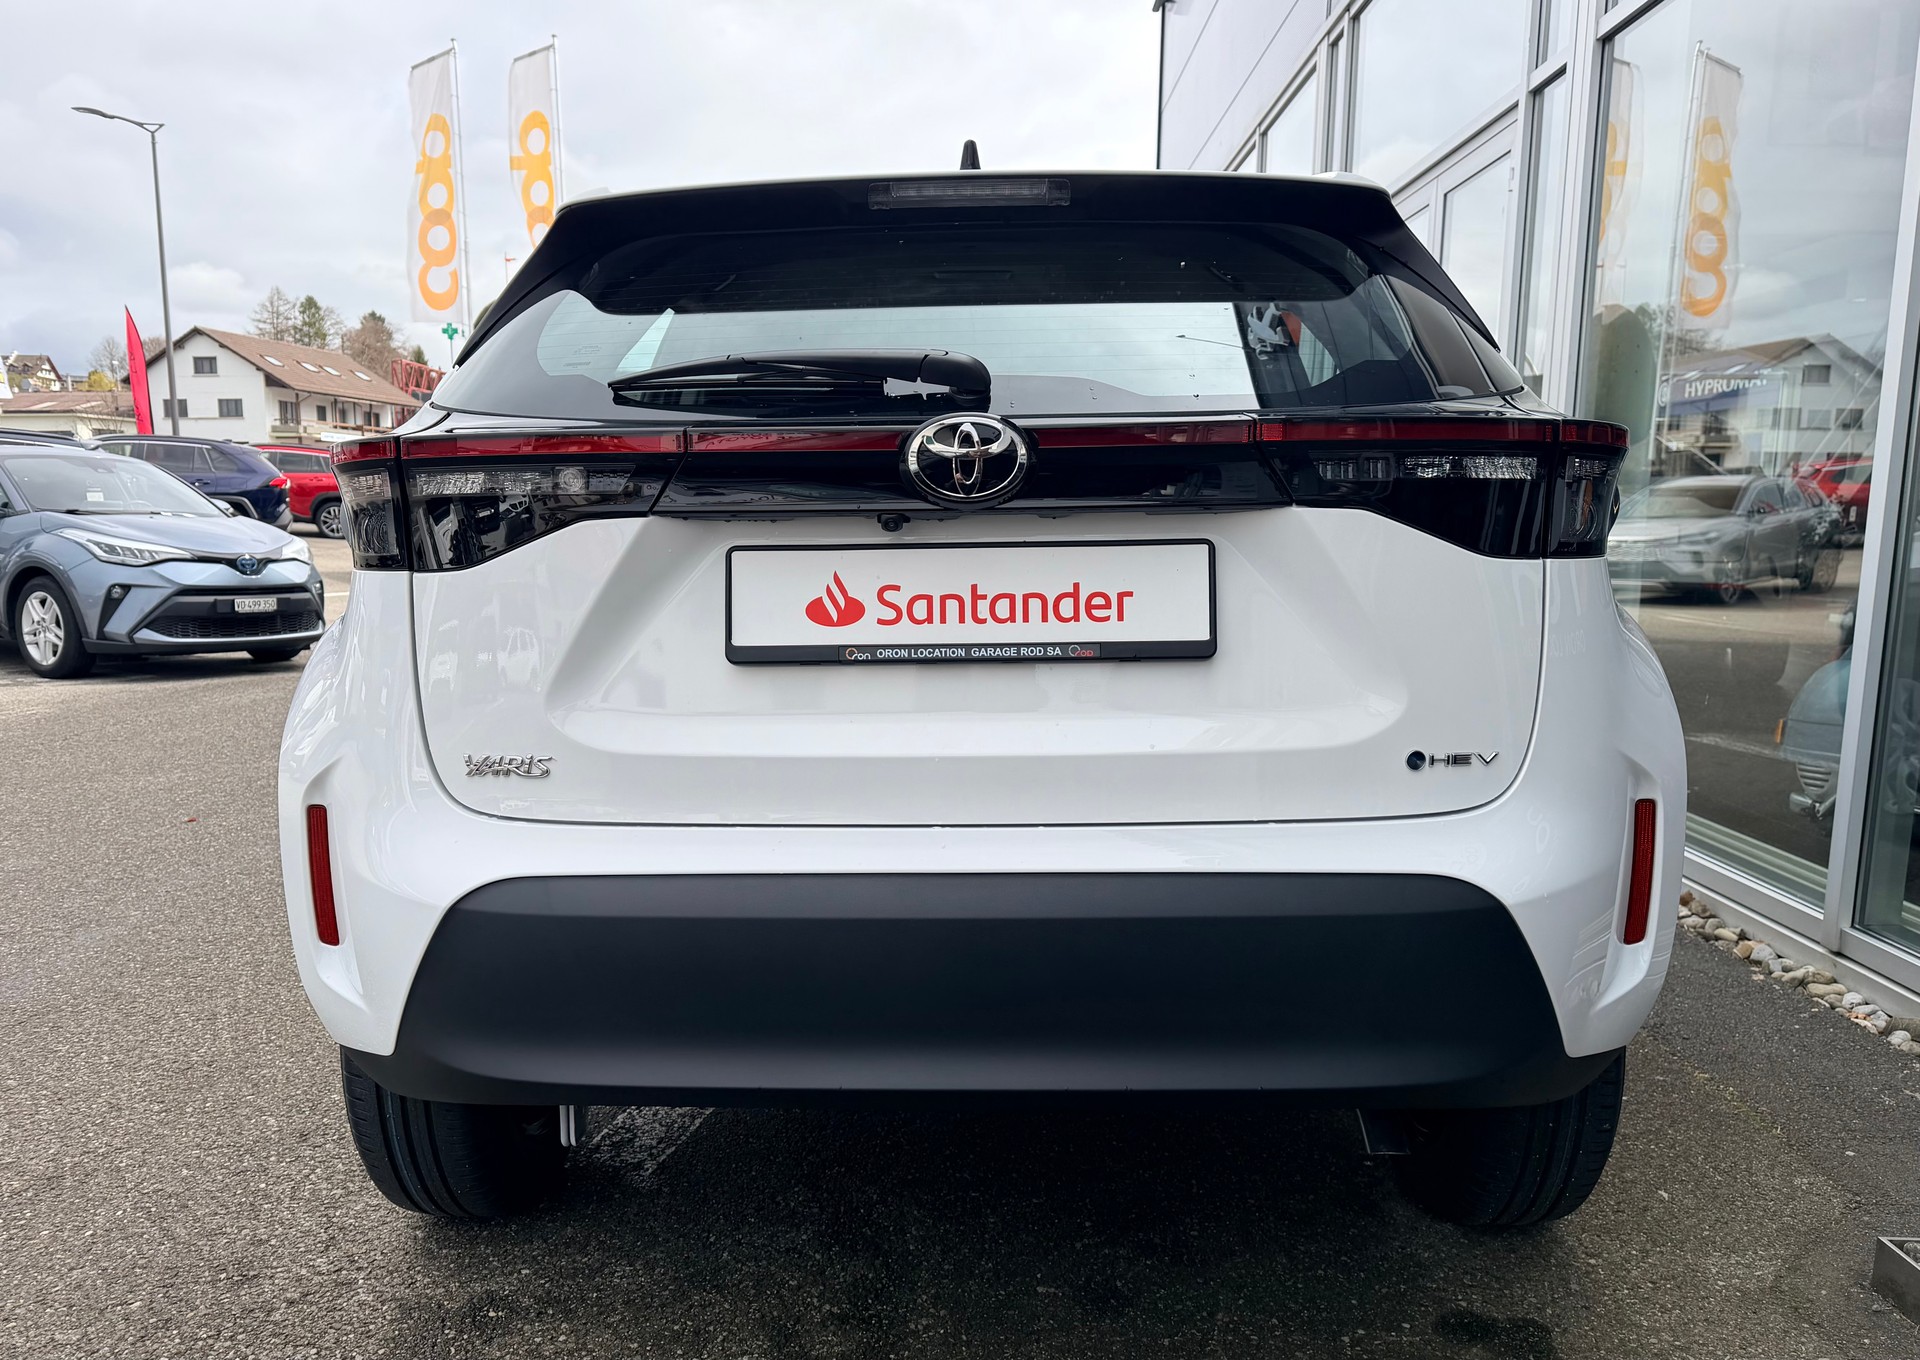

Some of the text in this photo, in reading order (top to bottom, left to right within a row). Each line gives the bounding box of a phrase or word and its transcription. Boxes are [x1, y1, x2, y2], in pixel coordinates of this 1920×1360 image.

[236, 600, 276, 609] VD 499 350
[876, 582, 1134, 626] Santander
[876, 646, 1062, 658] ORON LOCATION GARAGE ROD SA
[1428, 751, 1499, 768] HEV
